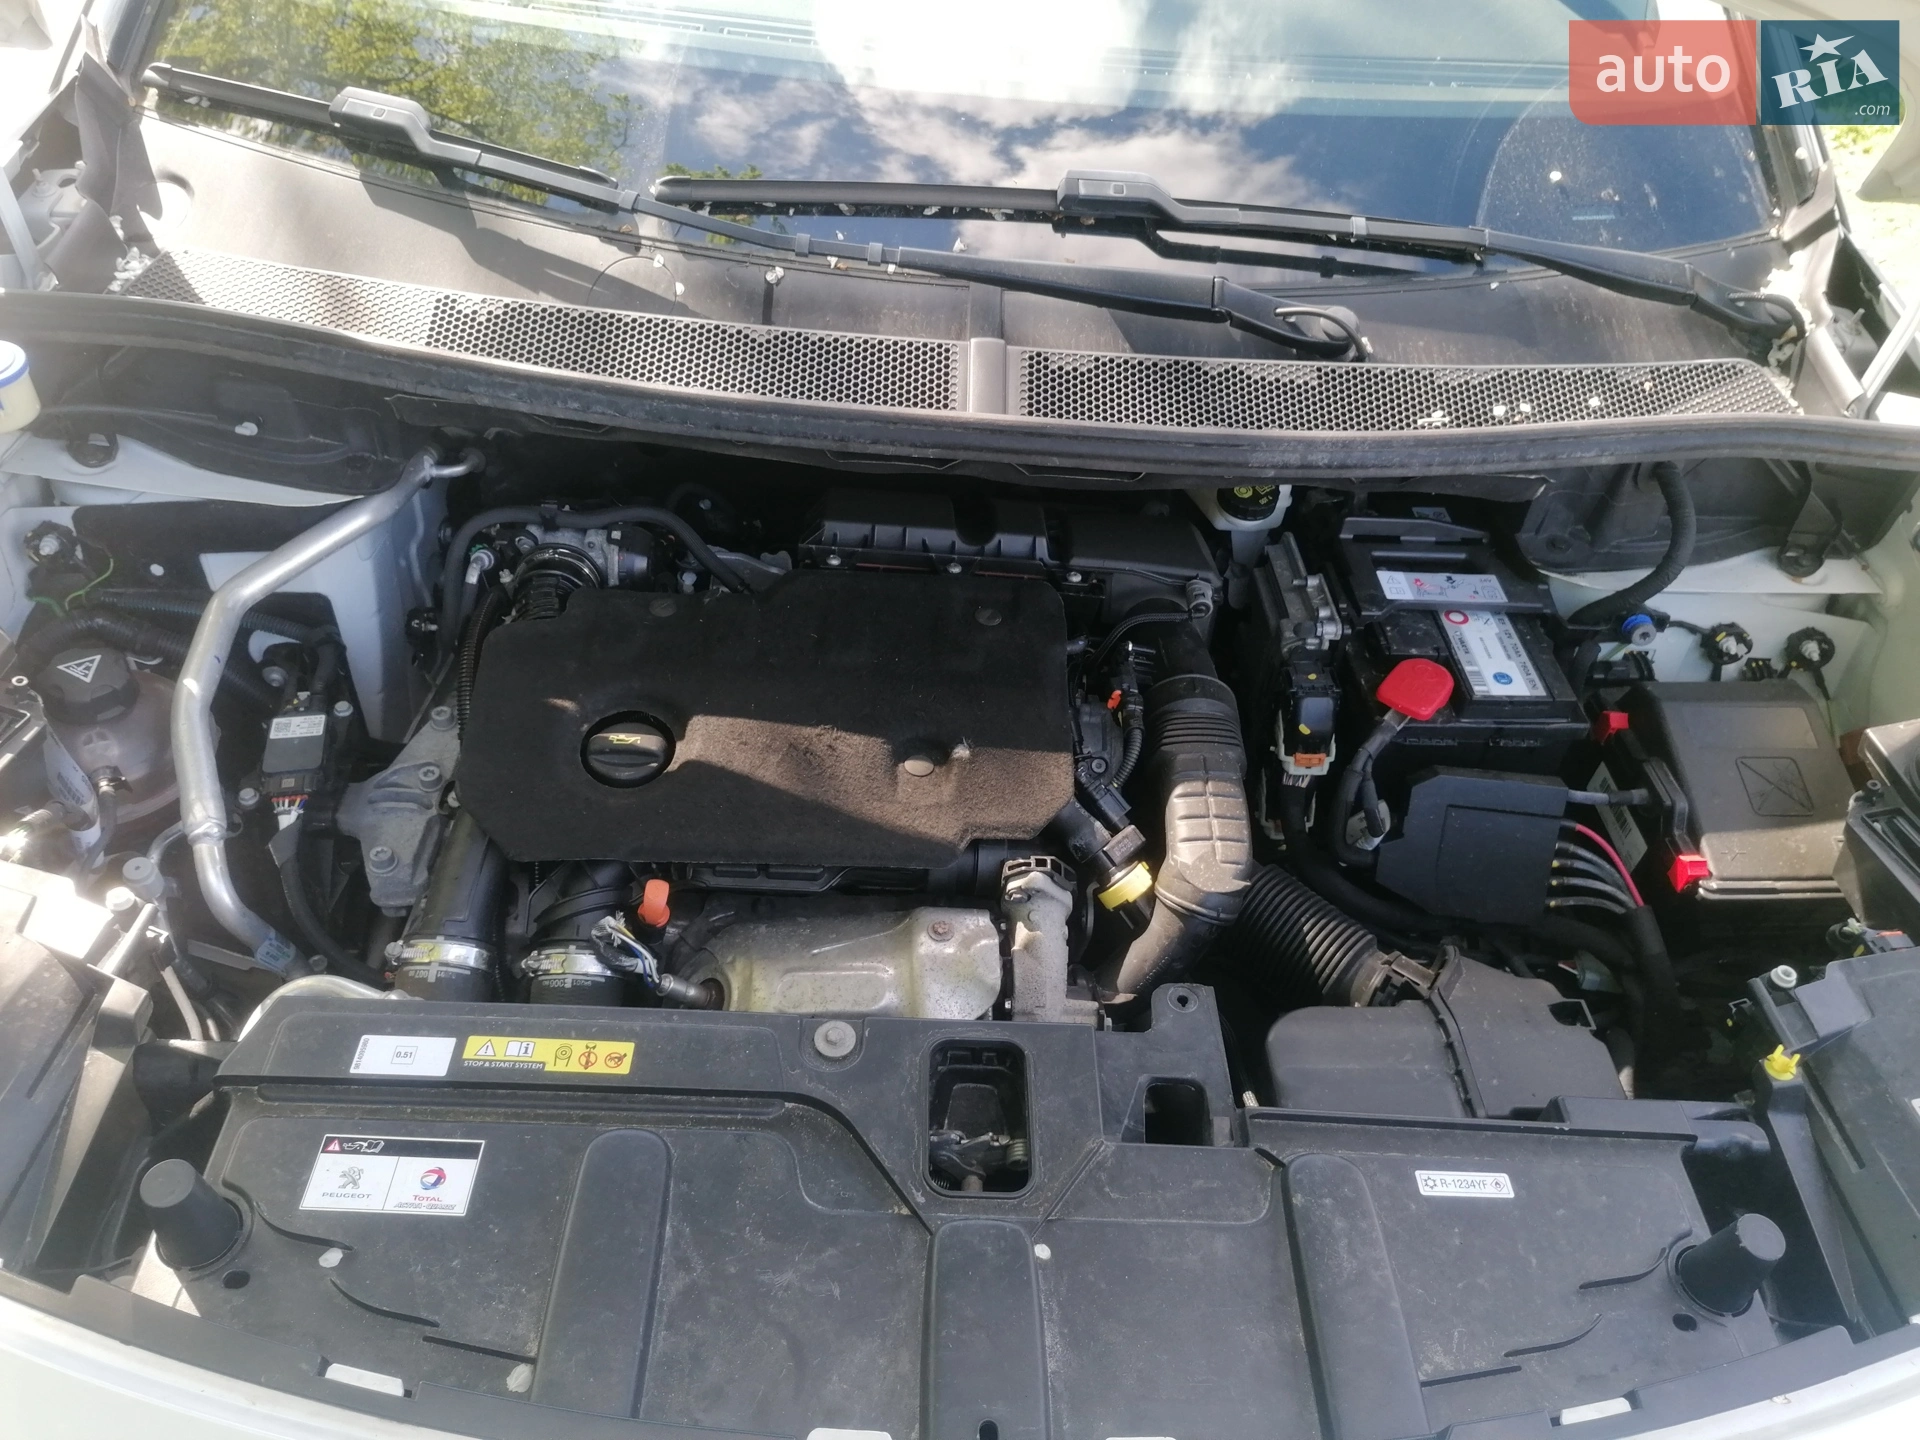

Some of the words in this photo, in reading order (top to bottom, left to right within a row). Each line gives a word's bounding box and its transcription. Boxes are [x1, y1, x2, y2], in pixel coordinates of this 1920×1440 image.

[395, 1050, 413, 1059] 0.51
[1440, 1178, 1488, 1190] R-1234YF
[321, 1191, 372, 1199] PEUGEOT
